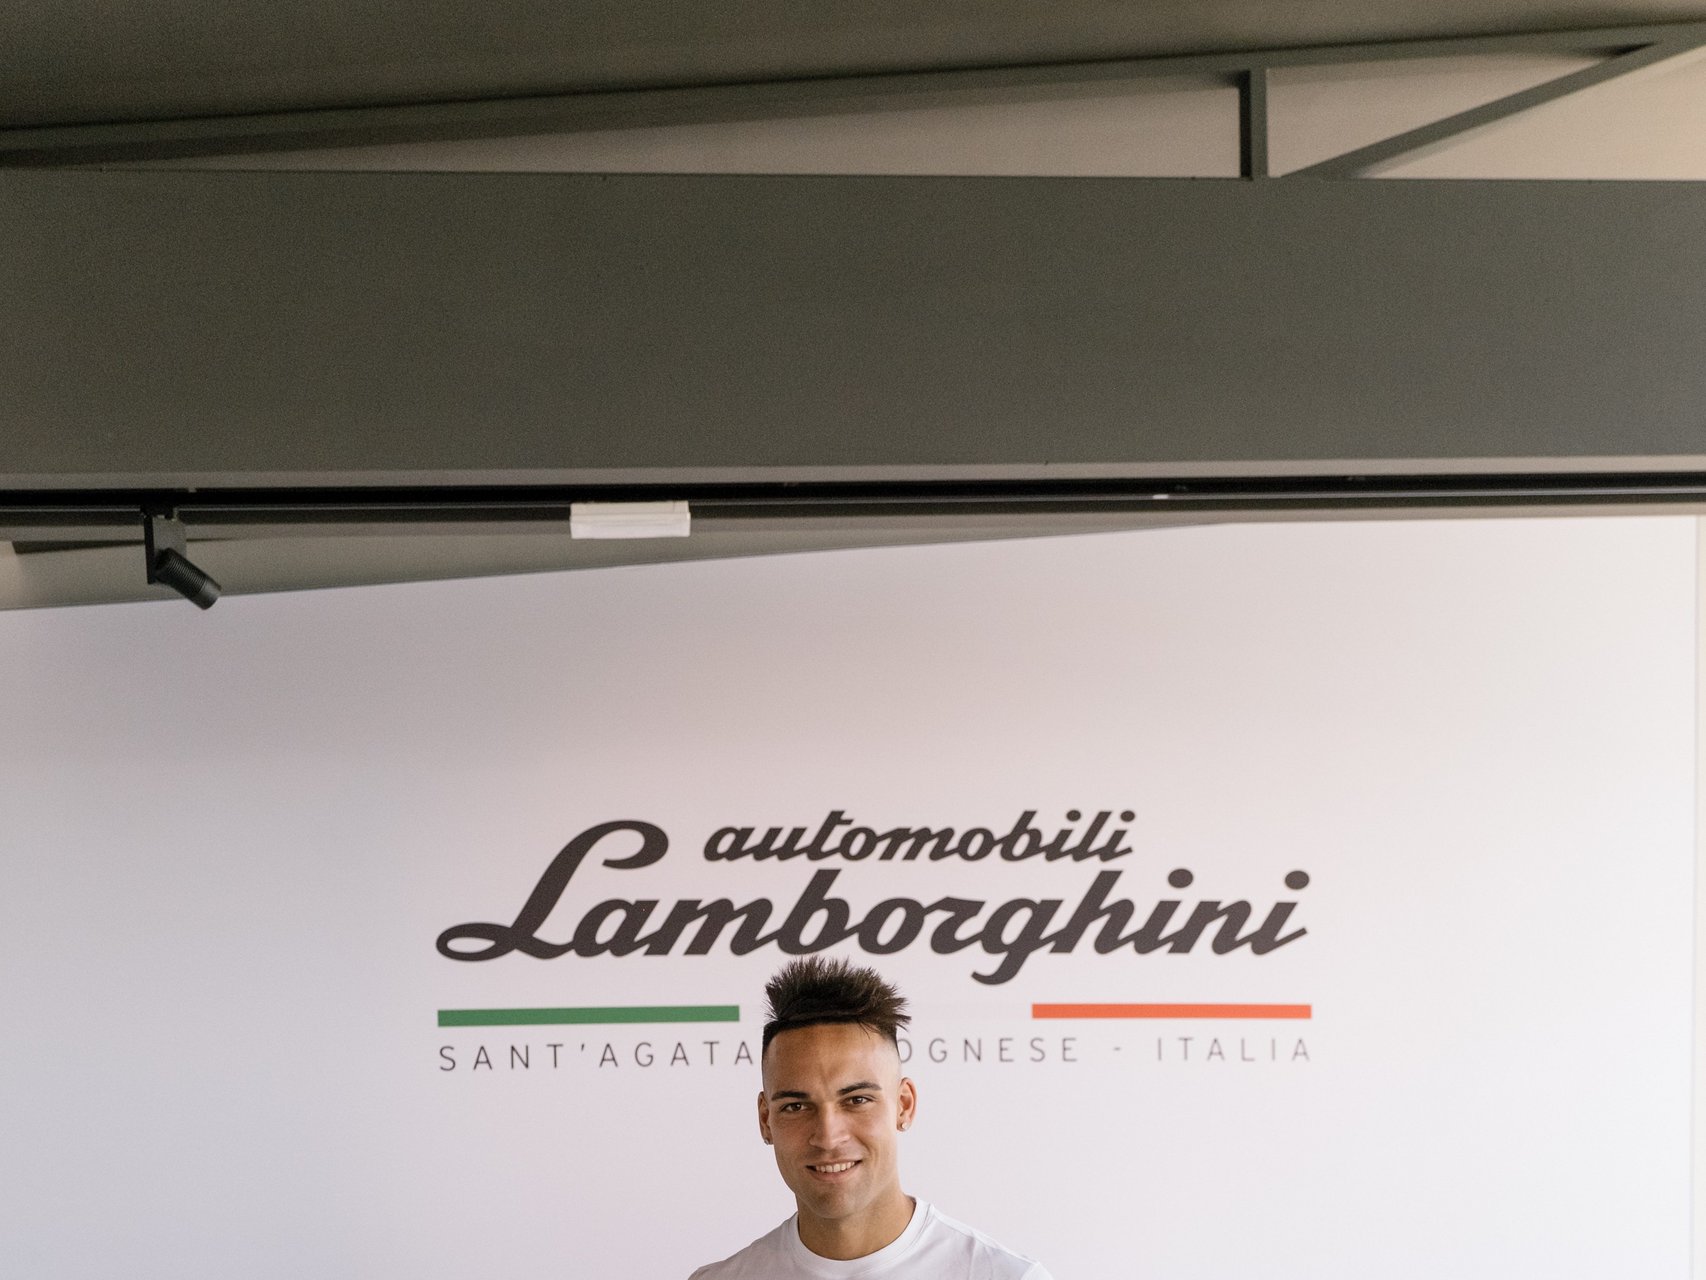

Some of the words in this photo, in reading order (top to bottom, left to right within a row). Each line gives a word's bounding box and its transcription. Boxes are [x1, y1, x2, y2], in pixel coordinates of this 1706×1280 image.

[704, 810, 1135, 863] automobili
[435, 818, 1310, 986] Lamborghini
[437, 1038, 754, 1073] SANT'AGATA
[894, 1036, 1077, 1065] OGNESE
[1157, 1037, 1310, 1062] ITALIA
